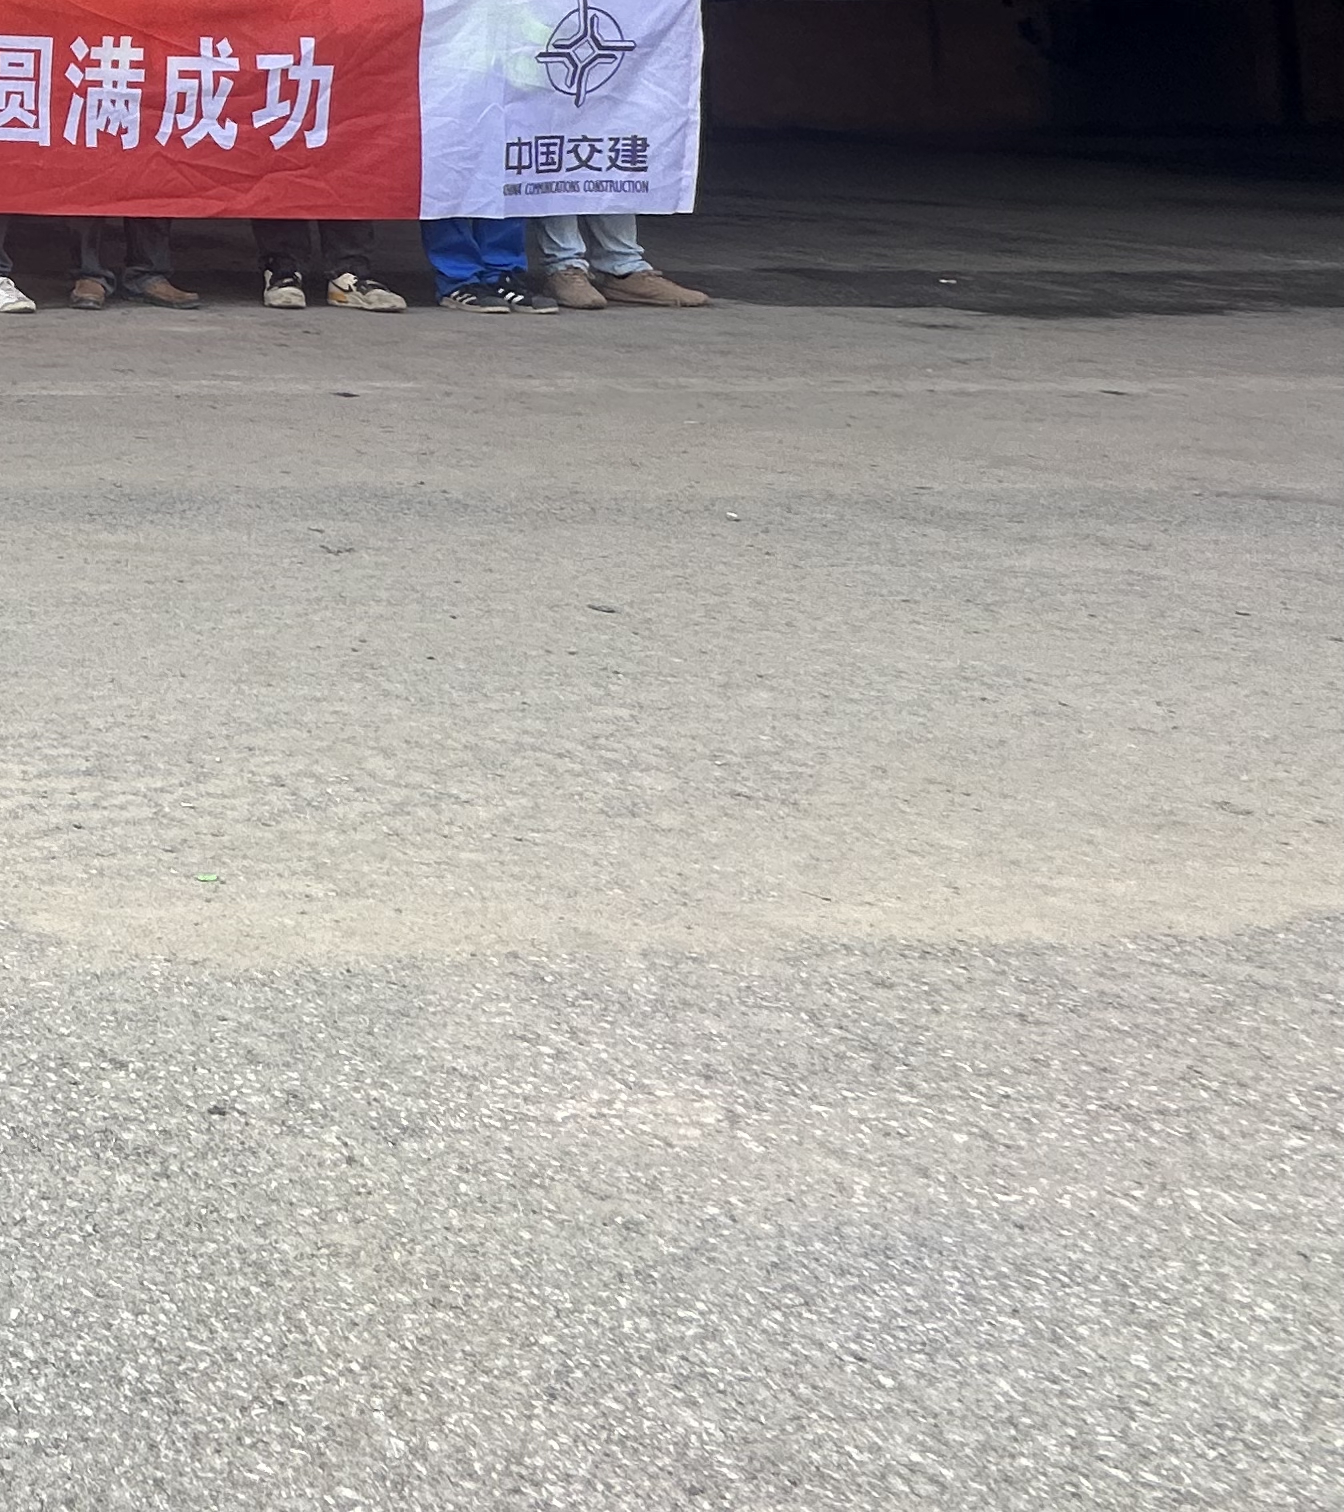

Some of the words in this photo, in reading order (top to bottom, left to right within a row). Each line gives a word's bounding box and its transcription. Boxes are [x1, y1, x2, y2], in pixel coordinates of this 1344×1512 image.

[505, 134, 650, 175] 中国交建
[583, 179, 650, 194] CONSTRUCTION
